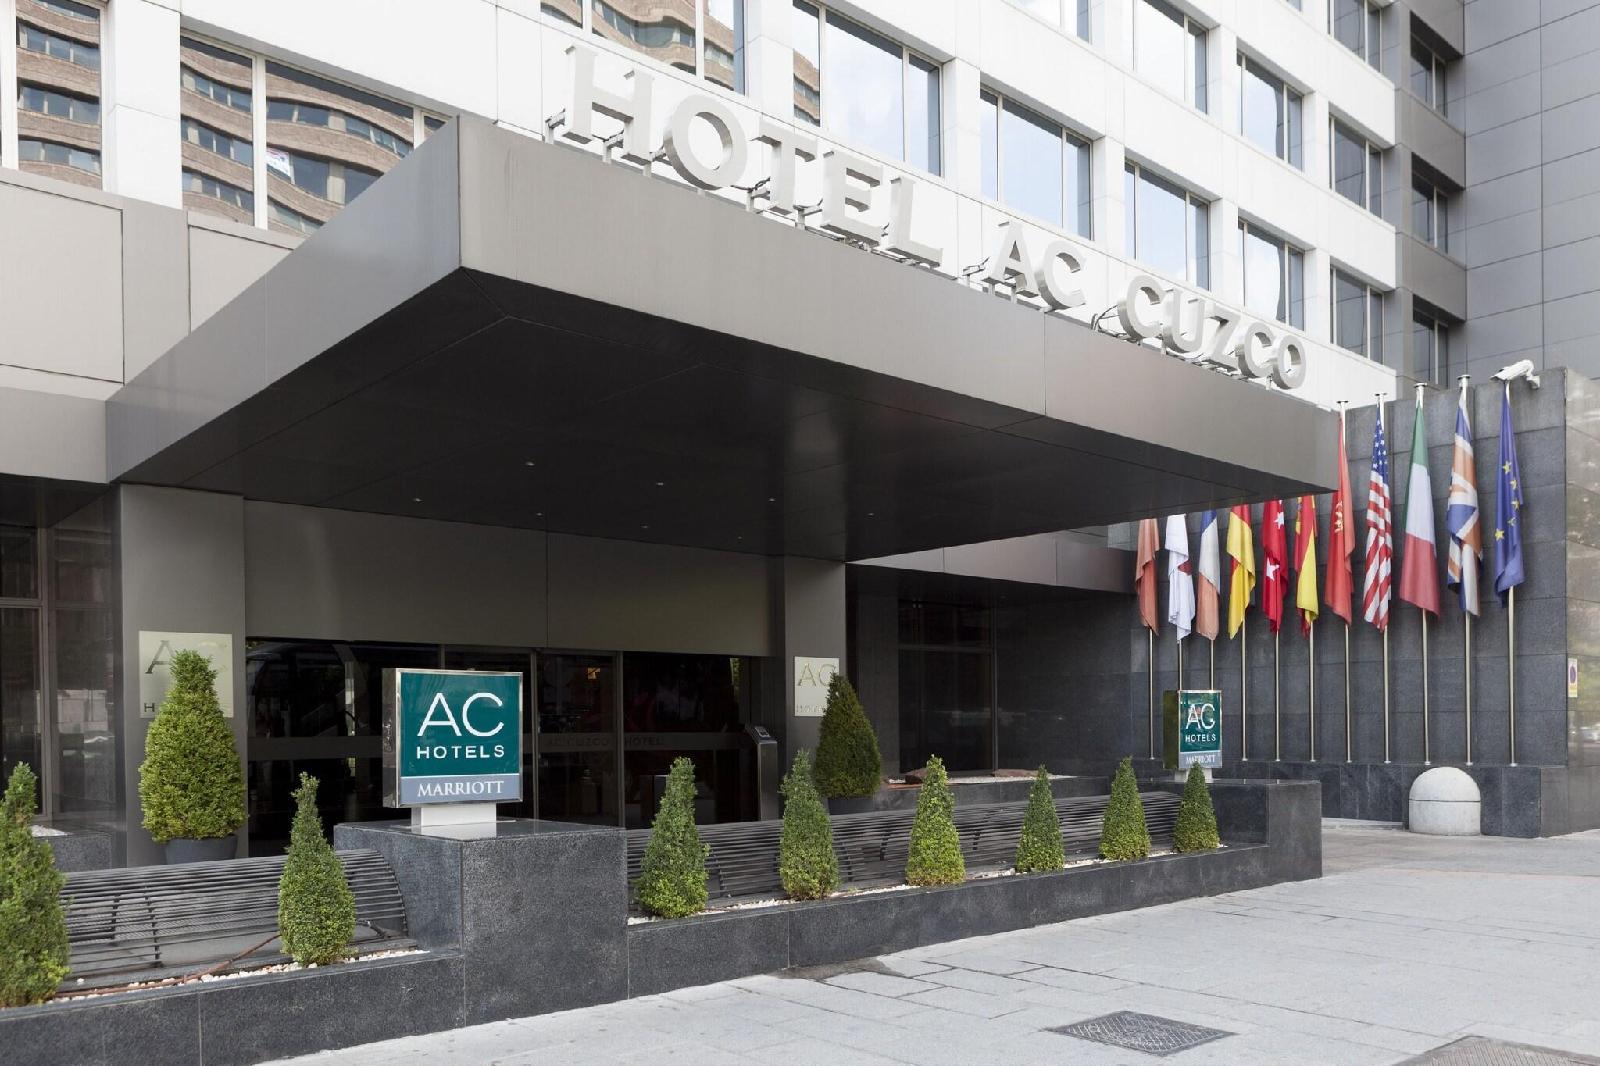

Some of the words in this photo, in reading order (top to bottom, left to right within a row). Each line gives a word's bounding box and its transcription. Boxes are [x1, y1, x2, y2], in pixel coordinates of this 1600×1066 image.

[565, 45, 943, 268] HOTEL
[981, 219, 1087, 310] AC
[1117, 275, 1306, 389] CUZCO
[417, 692, 505, 737] AC
[1185, 703, 1216, 730] AC
[1185, 733, 1216, 743] HOTELS
[416, 744, 505, 759] HOTELS
[417, 780, 505, 797] MARRIOTT
